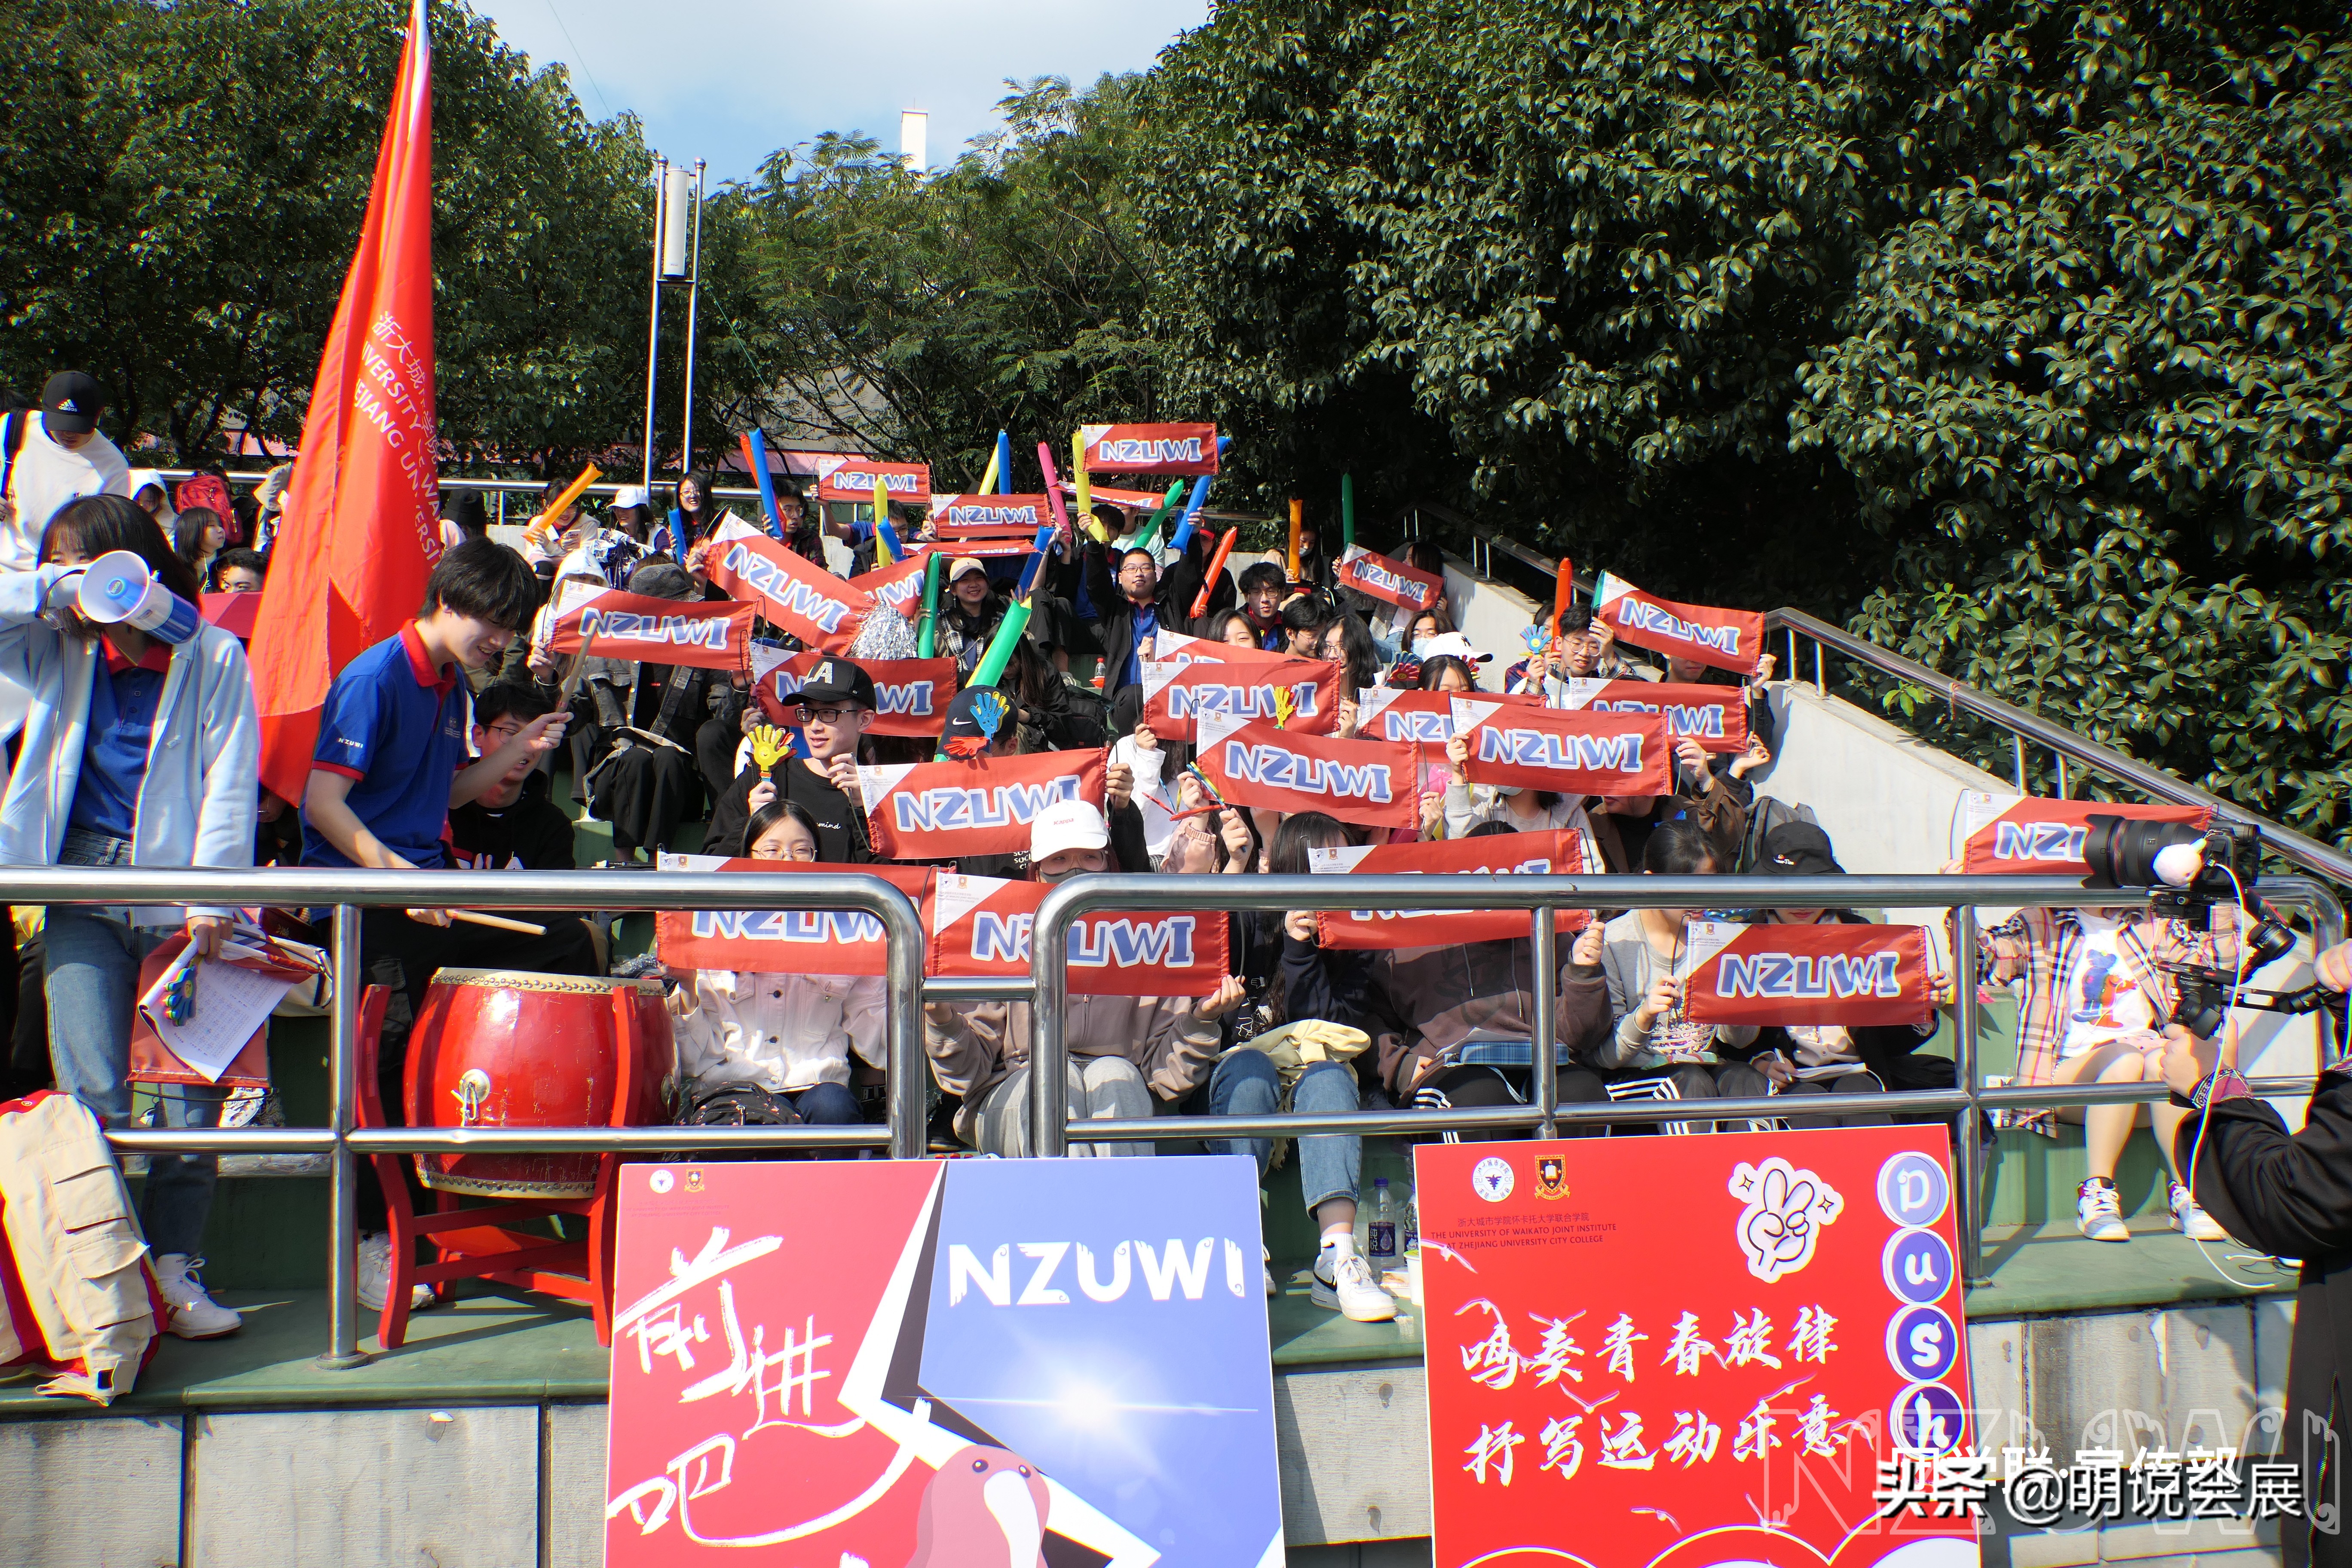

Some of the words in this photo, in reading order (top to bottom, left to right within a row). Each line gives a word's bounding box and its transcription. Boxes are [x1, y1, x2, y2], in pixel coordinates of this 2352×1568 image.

[1099, 437, 1202, 463] NZUWI
[949, 505, 1038, 526] NZUWI
[722, 542, 849, 634] NZUWI
[1352, 560, 1429, 603] NZUWI
[579, 606, 731, 649] NZUWI
[1618, 597, 1740, 655] NZUWI
[803, 662, 833, 686] LA
[338, 738, 364, 748] NZUWI
[1479, 725, 1645, 772] NZUWI
[1225, 740, 1392, 803] NZUWI
[1716, 951, 1901, 998] NZUWI
[1370, 1228, 1378, 1251] 纯悦
[1449, 1230, 1496, 1238] UNIVERSITY
[1512, 1227, 1549, 1235] WAIKATO
[1552, 1225, 1575, 1235] JOINT
[1577, 1224, 1617, 1232] INSTITUTE
[1458, 1212, 1589, 1227] 浙大城市学院怀卡托大学联合学院
[1458, 1241, 1498, 1250] ZHEJIANG
[1500, 1238, 1547, 1247] UNIVERSITY
[950, 1236, 1246, 1308] NZUWI
[1459, 1302, 1841, 1390] 鸣奏青春旋律
[1462, 1393, 1849, 1487] 抒写运动乐意
